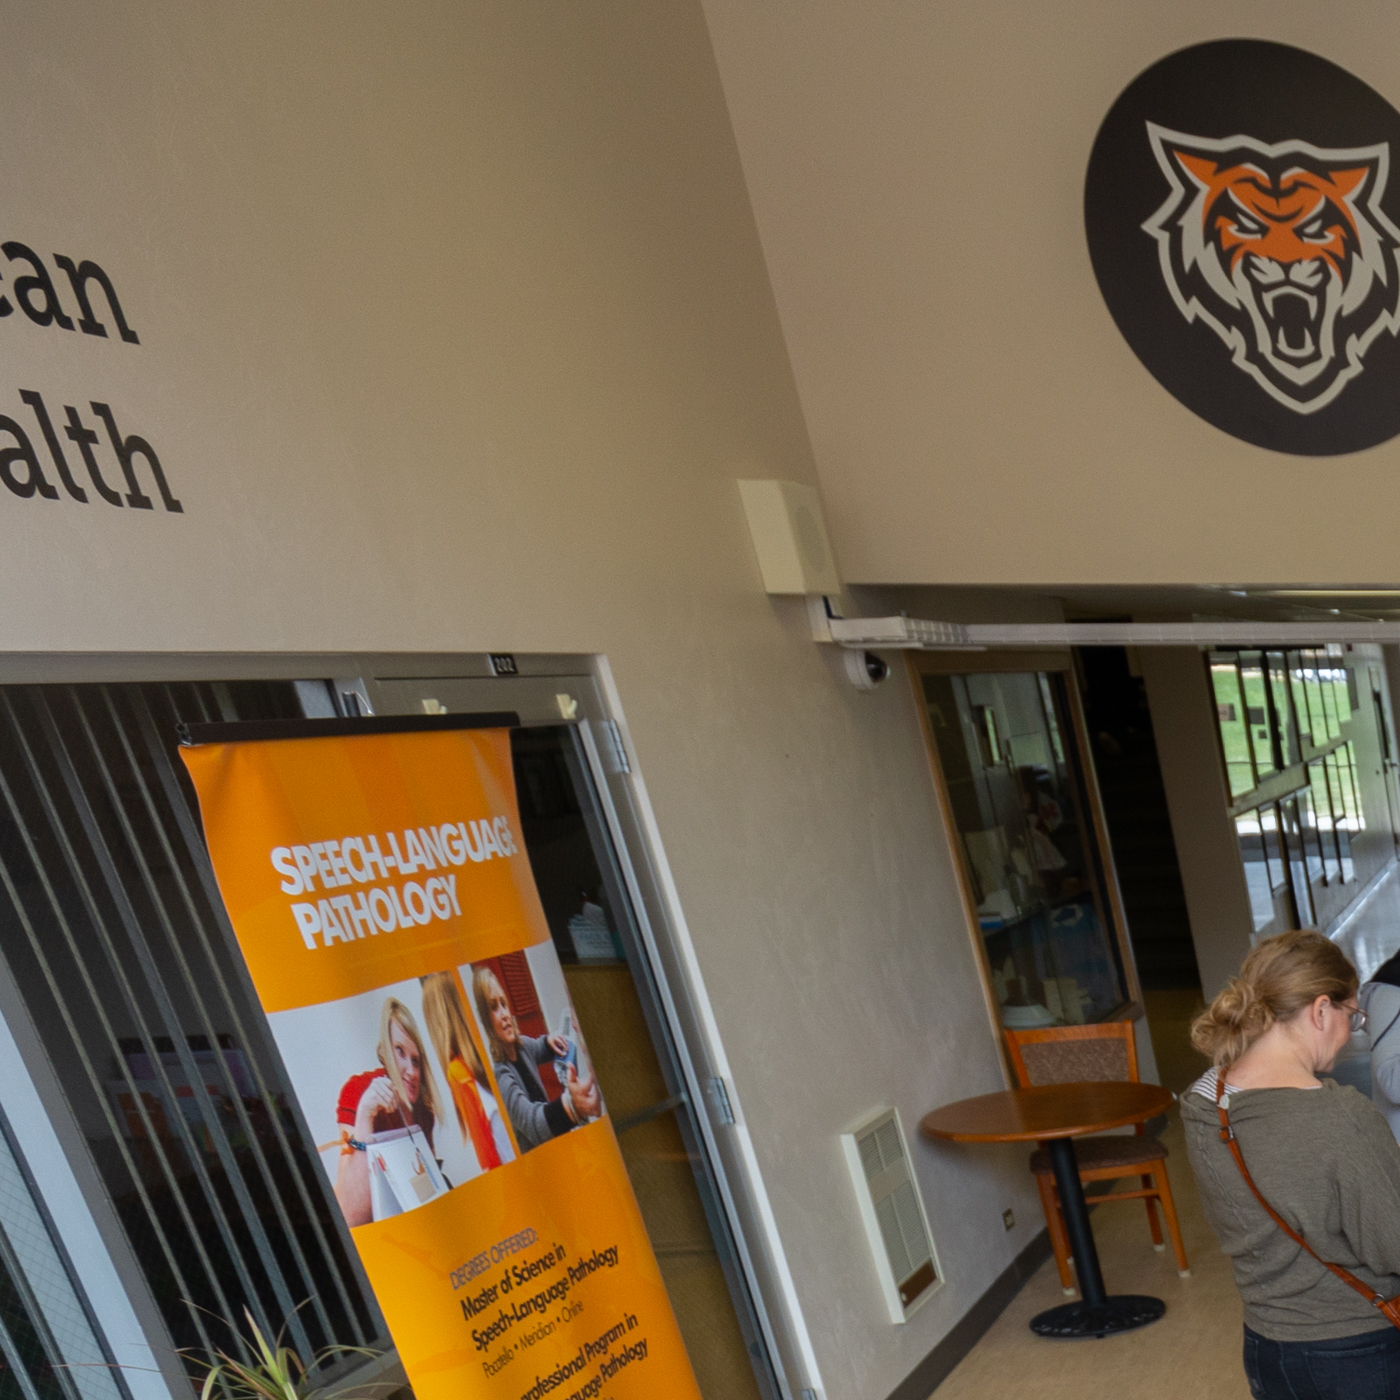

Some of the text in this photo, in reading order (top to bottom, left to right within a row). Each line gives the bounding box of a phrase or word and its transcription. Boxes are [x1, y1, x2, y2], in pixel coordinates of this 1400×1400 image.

[291, 874, 462, 949] PATHOLOGY
[450, 1227, 540, 1290] DEGREES OFFERED:
[460, 1243, 567, 1321] Master of Science in
[471, 1245, 620, 1352] Speech-Language Pathology
[482, 1299, 584, 1379] Pocatello Meridian Online
[585, 1320, 627, 1364] Program
[626, 1312, 639, 1331] in
[600, 1338, 649, 1386] Pathology
